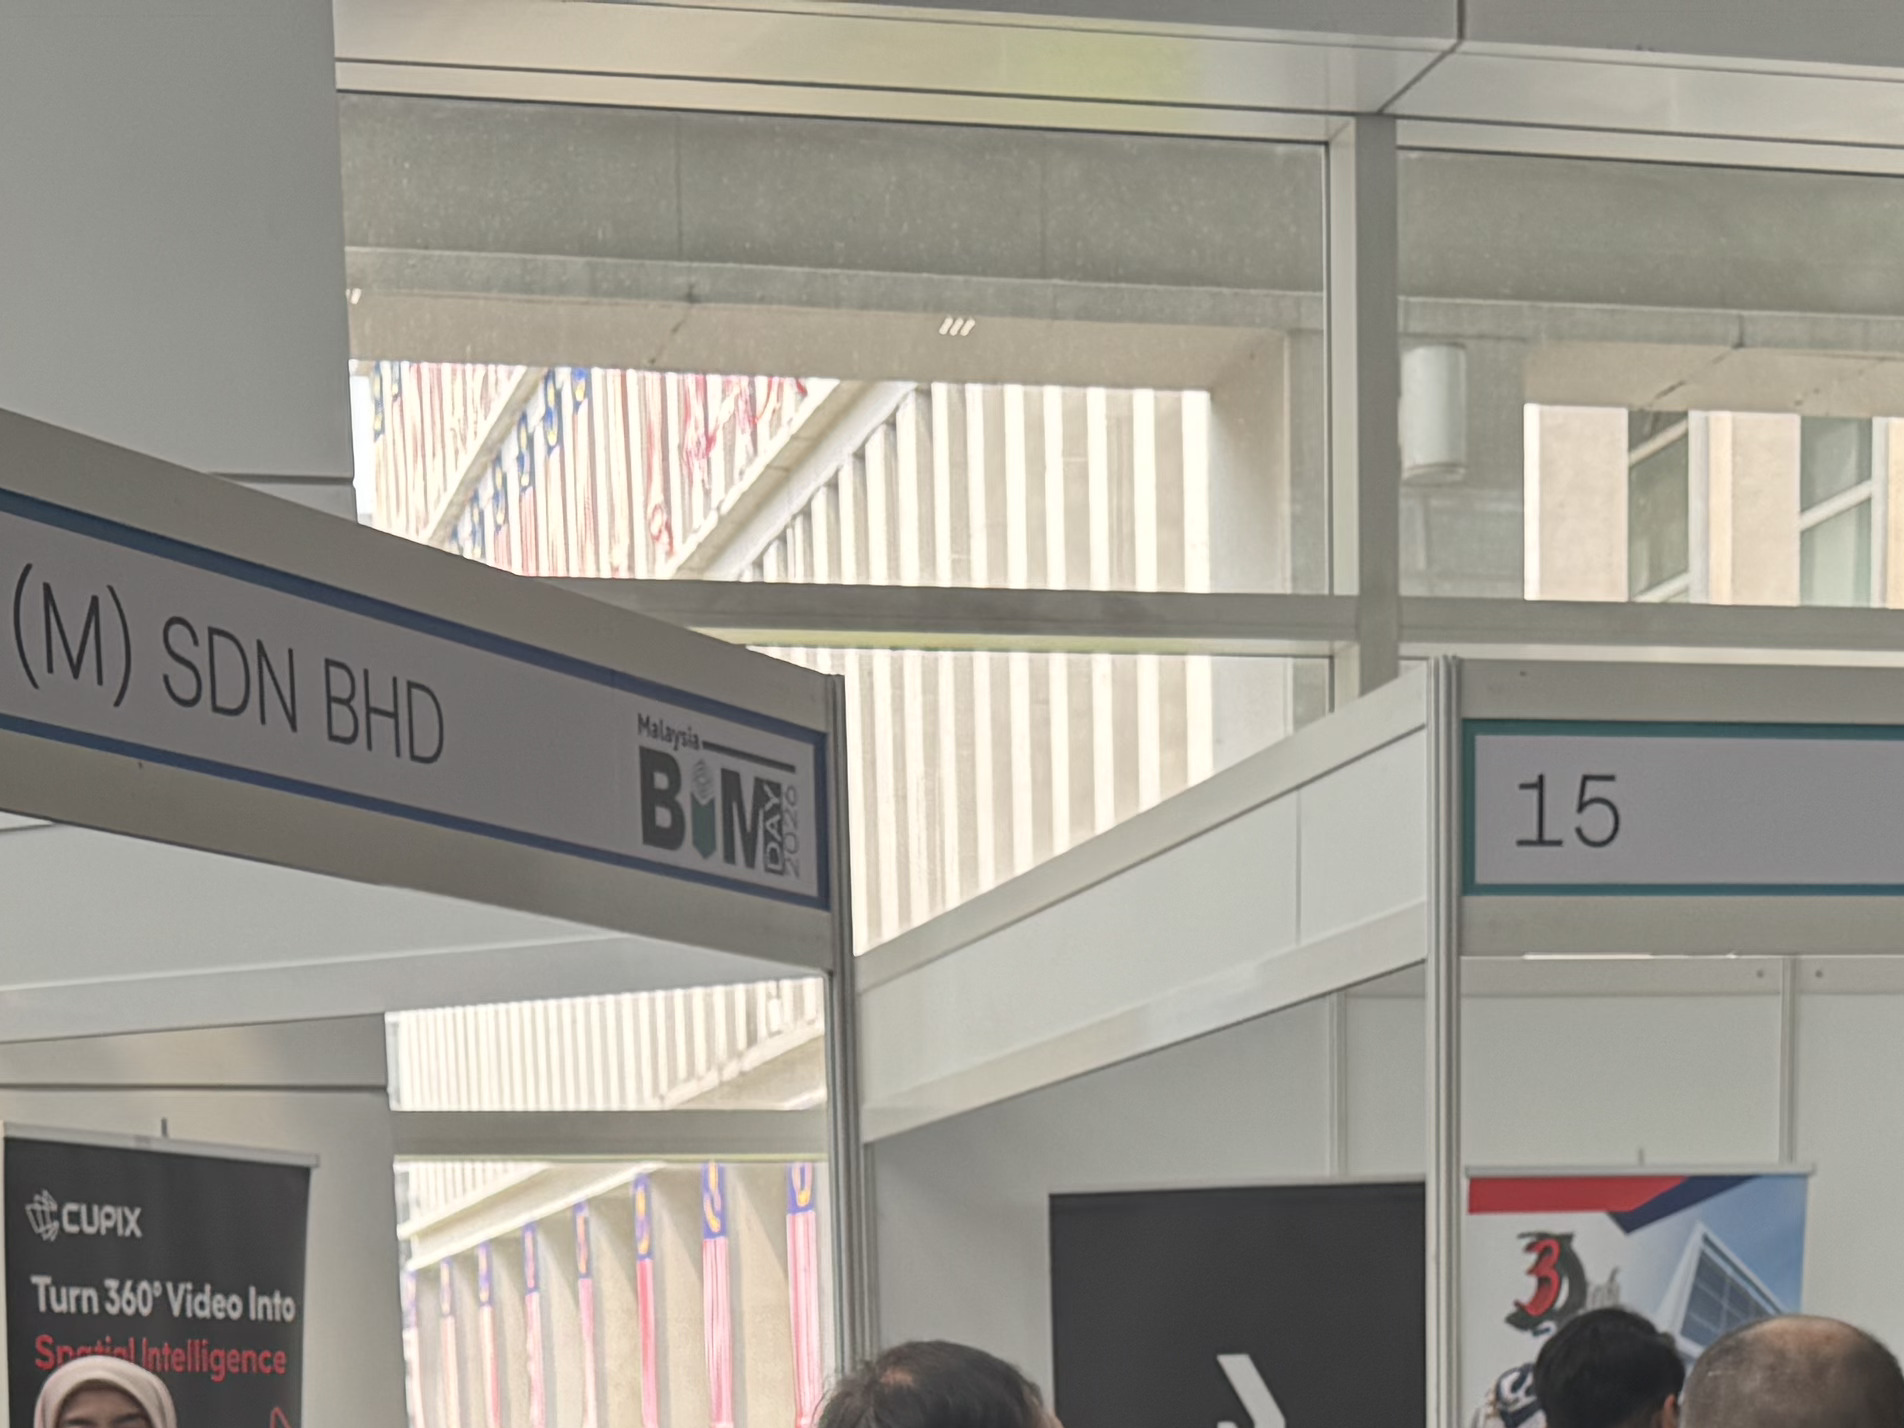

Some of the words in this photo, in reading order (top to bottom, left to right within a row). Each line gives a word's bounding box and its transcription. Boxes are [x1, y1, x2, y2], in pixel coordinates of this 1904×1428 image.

[13, 563, 131, 707] (M)
[162, 615, 298, 733] SDN
[325, 657, 444, 764] BHD
[637, 712, 700, 751] Malaysia
[763, 783, 784, 873] DAY
[1516, 773, 1621, 848] 15
[62, 1202, 142, 1238] CUPIX
[30, 1275, 99, 1315] Turn
[166, 1282, 243, 1321] Video
[249, 1286, 296, 1323] Into
[142, 1337, 287, 1383] Intelligence
